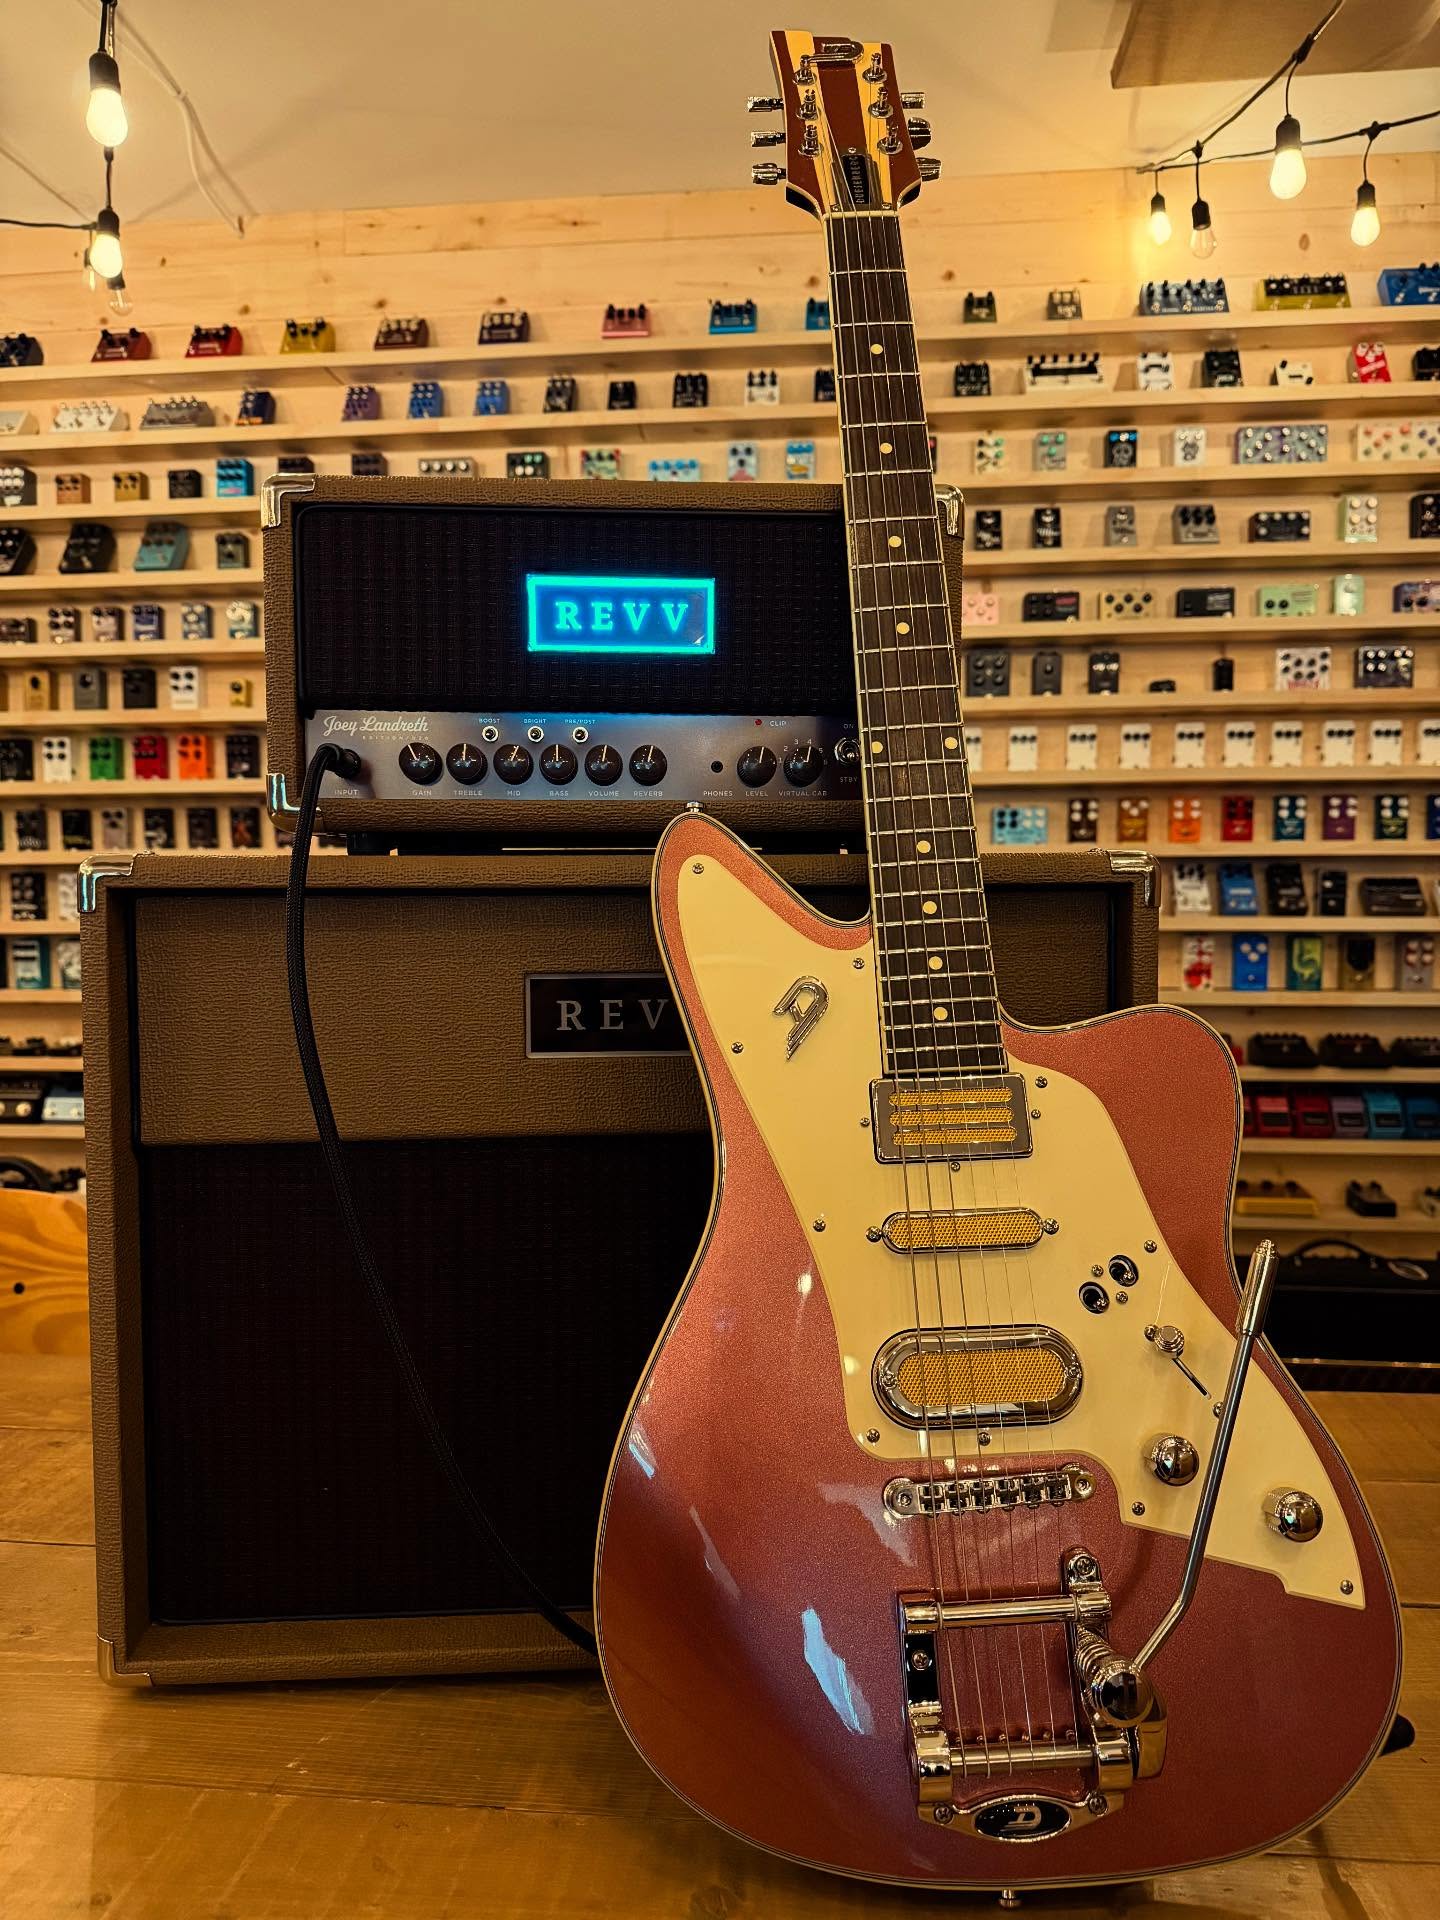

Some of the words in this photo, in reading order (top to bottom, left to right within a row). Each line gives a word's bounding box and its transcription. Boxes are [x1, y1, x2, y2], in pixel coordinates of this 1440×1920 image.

[555, 600, 689, 632] REVV
[323, 715, 358, 737] Joey
[359, 715, 429, 733] Landreth
[556, 1000, 668, 1031] REV
